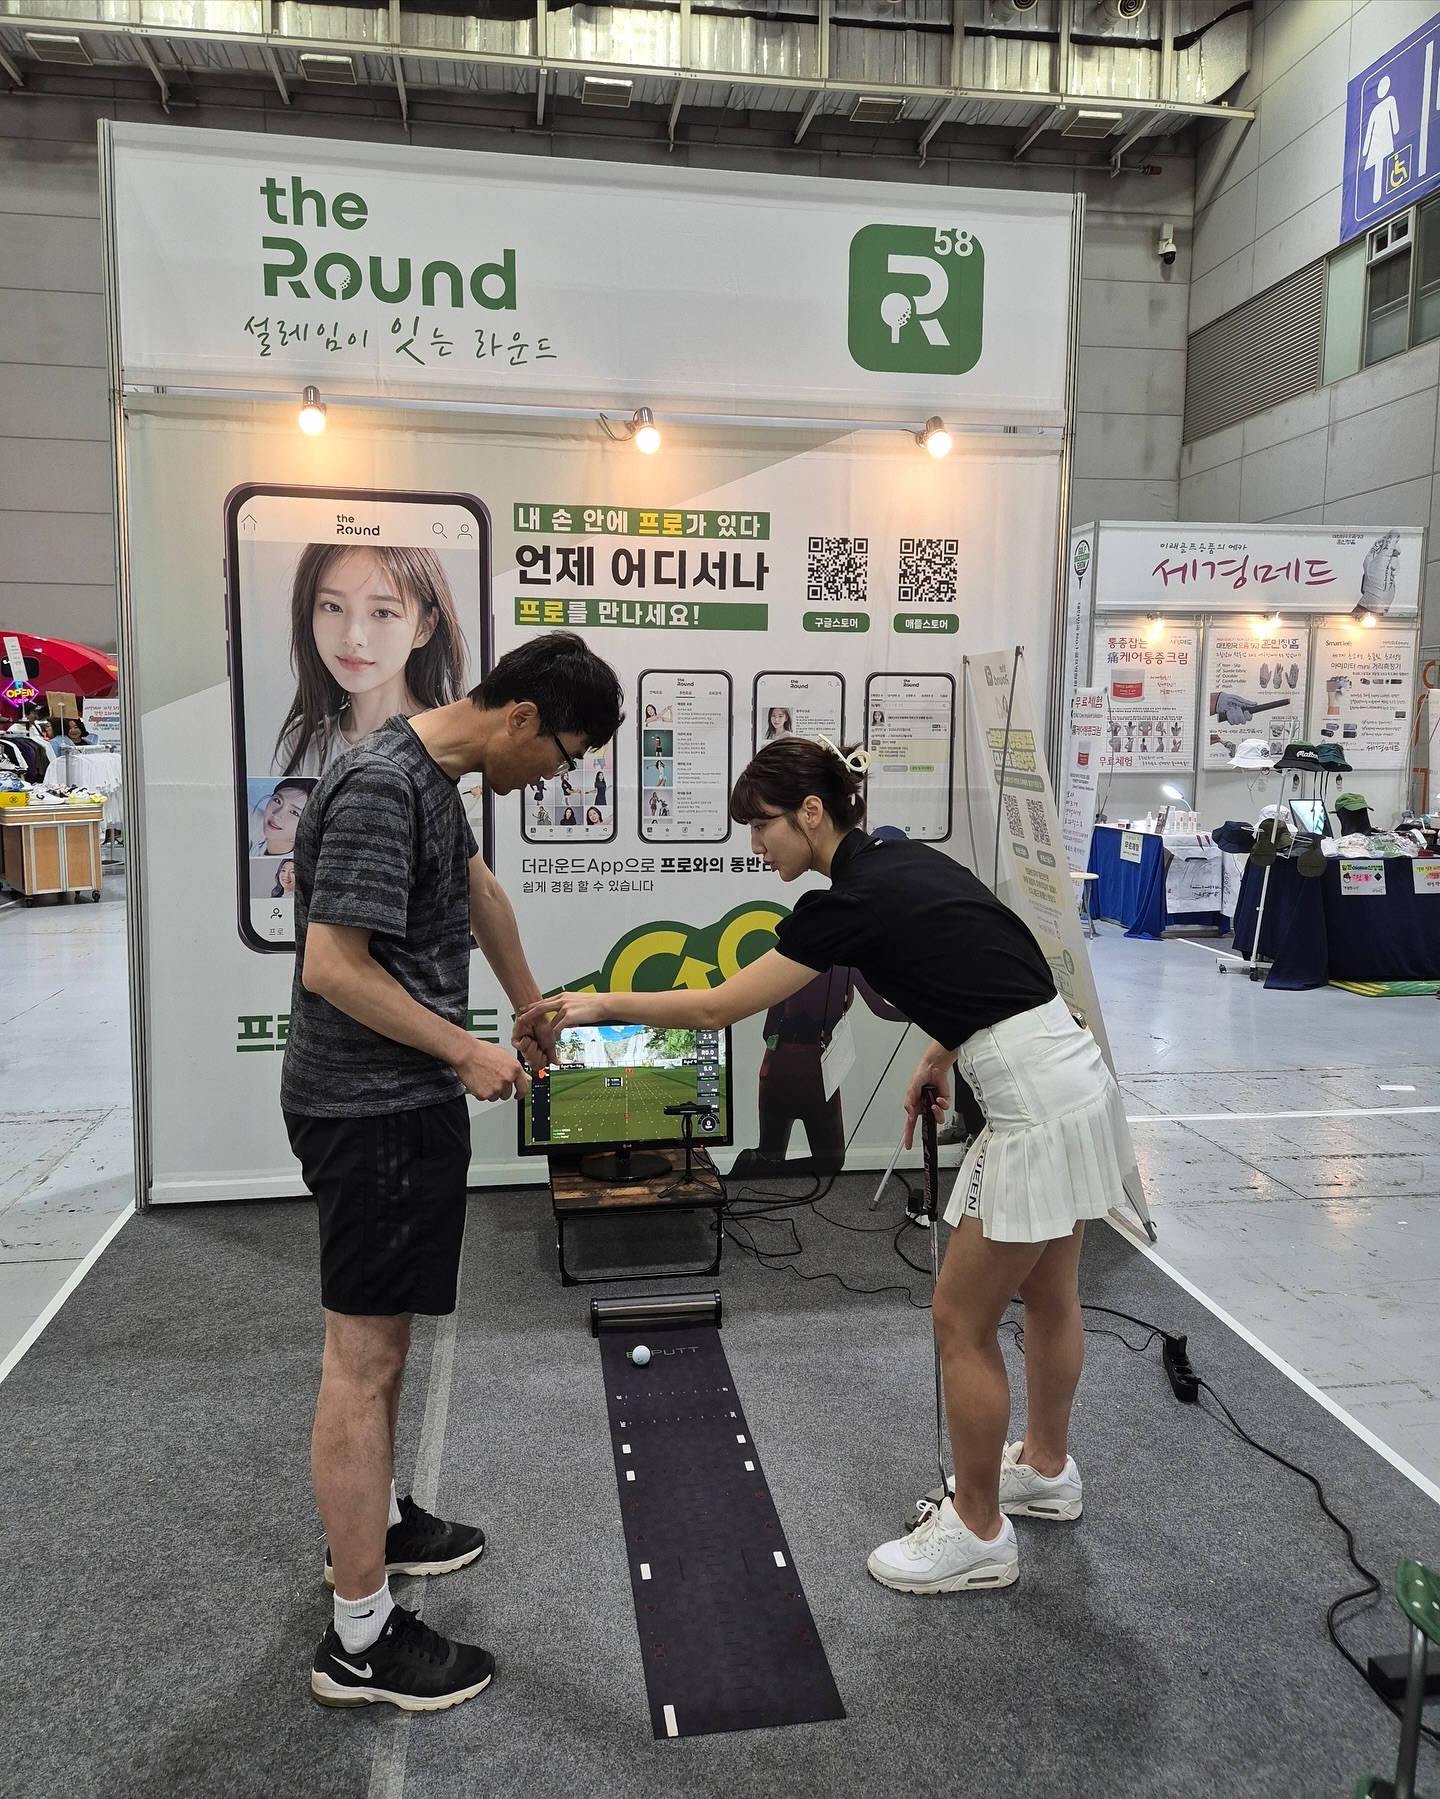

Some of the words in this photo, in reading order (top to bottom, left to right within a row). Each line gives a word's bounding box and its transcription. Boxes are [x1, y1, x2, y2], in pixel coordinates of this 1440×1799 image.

[260, 176, 368, 230] the
[933, 226, 974, 257] 58
[262, 236, 517, 310] Round
[244, 316, 368, 357] 설레임이
[391, 316, 453, 365] 잇는
[475, 329, 557, 365] 라운드
[336, 514, 355, 524] the
[336, 524, 380, 537] Round
[518, 506, 540, 530] 내
[552, 508, 573, 532] 손
[583, 508, 628, 533] 안에
[639, 510, 707, 537] 프로가
[717, 513, 761, 538] 있다
[515, 545, 594, 586] 언제
[612, 547, 770, 591] 어디서나
[1152, 555, 1338, 589] 세경메드
[520, 599, 588, 624] 프로를
[598, 601, 700, 626] 만나세요!
[814, 616, 858, 629] 구글스토어
[6, 688, 35, 698] OPEN
[522, 858, 655, 876] 더라운드App으로
[660, 856, 723, 873] 프로와의
[522, 880, 546, 893] 쉽게
[551, 880, 573, 893] 경험
[577, 880, 589, 893] 할
[593, 881, 604, 893] 수
[608, 880, 654, 893] 있습니다
[625, 1346, 699, 1358] EPUTT
